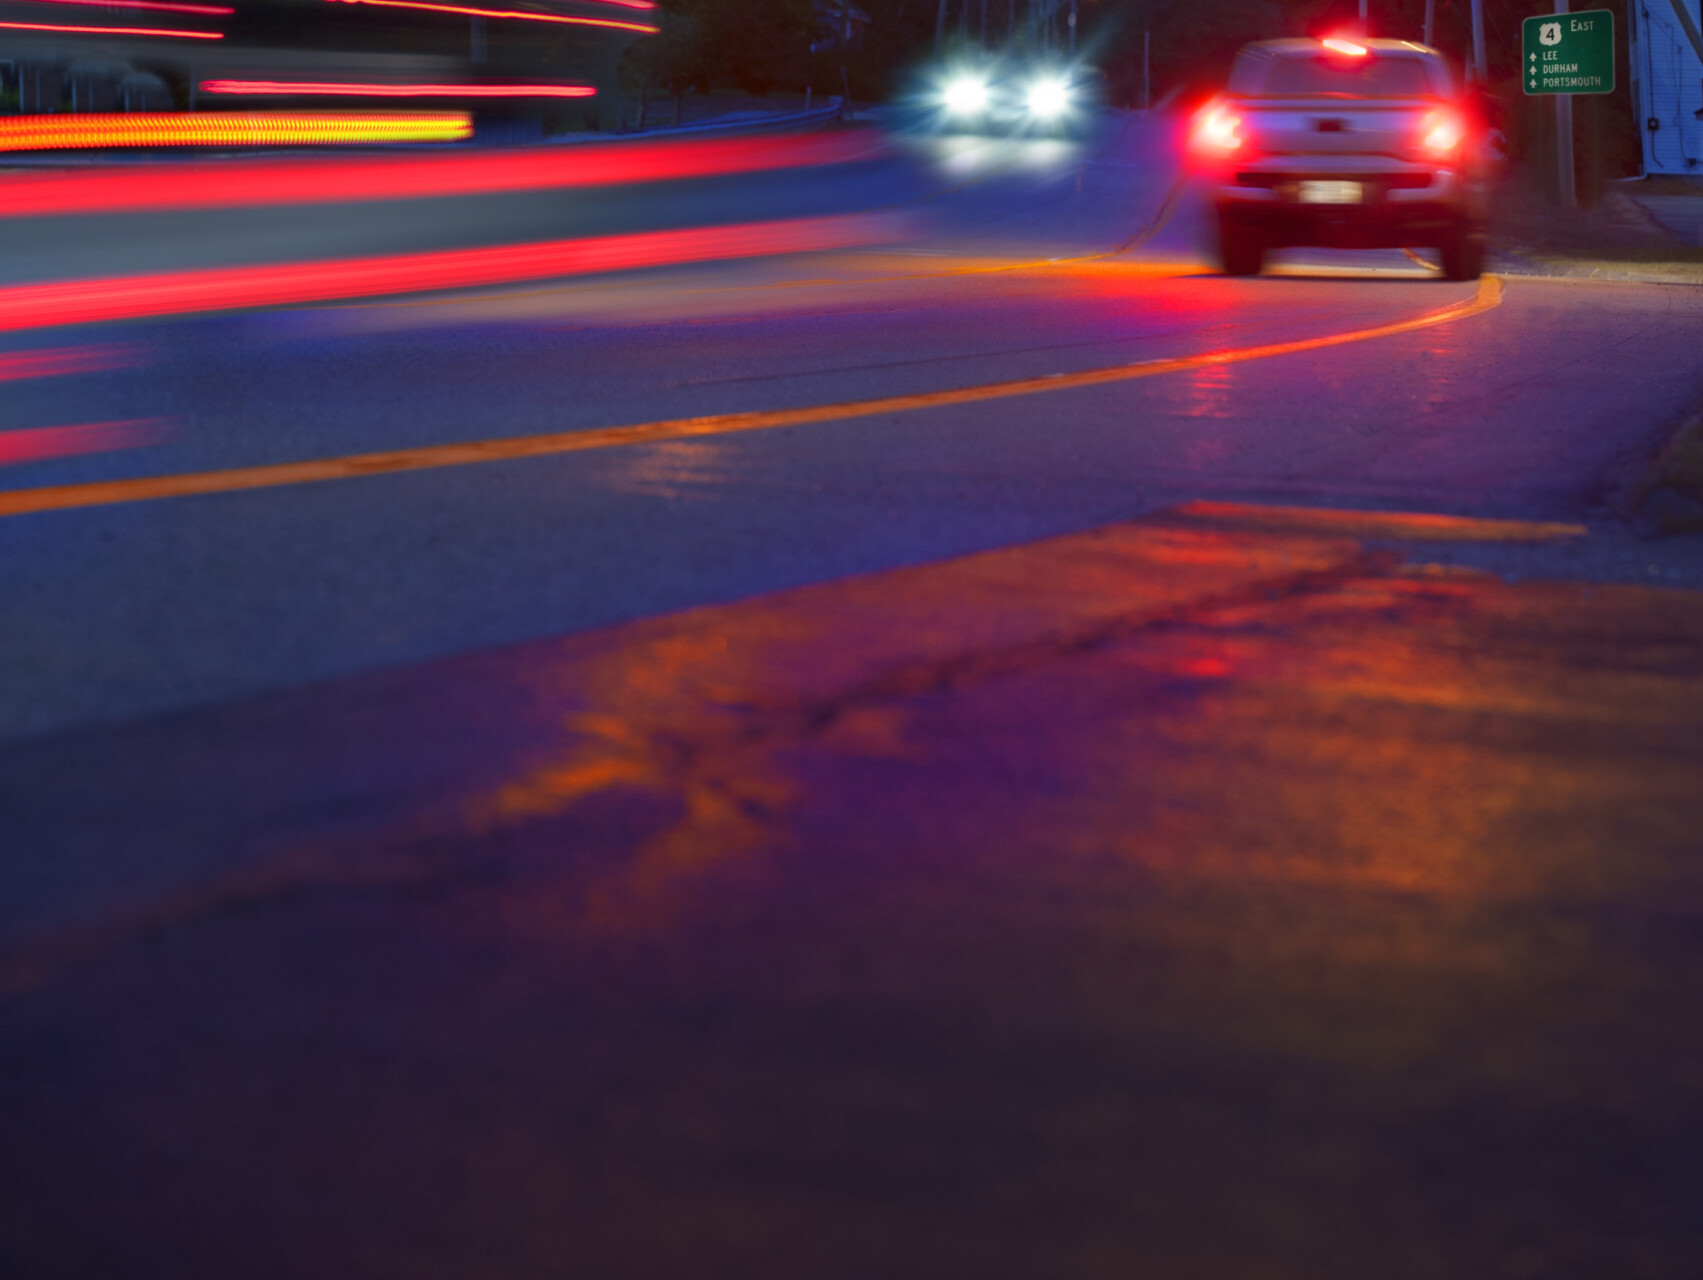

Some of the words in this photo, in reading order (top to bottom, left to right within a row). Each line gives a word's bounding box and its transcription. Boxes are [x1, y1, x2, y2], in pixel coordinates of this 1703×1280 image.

[1546, 28, 1555, 41] 4
[1543, 51, 1558, 60] LEE
[1543, 63, 1578, 74] DURHAM
[1543, 76, 1601, 88] PORTSMOUTH
